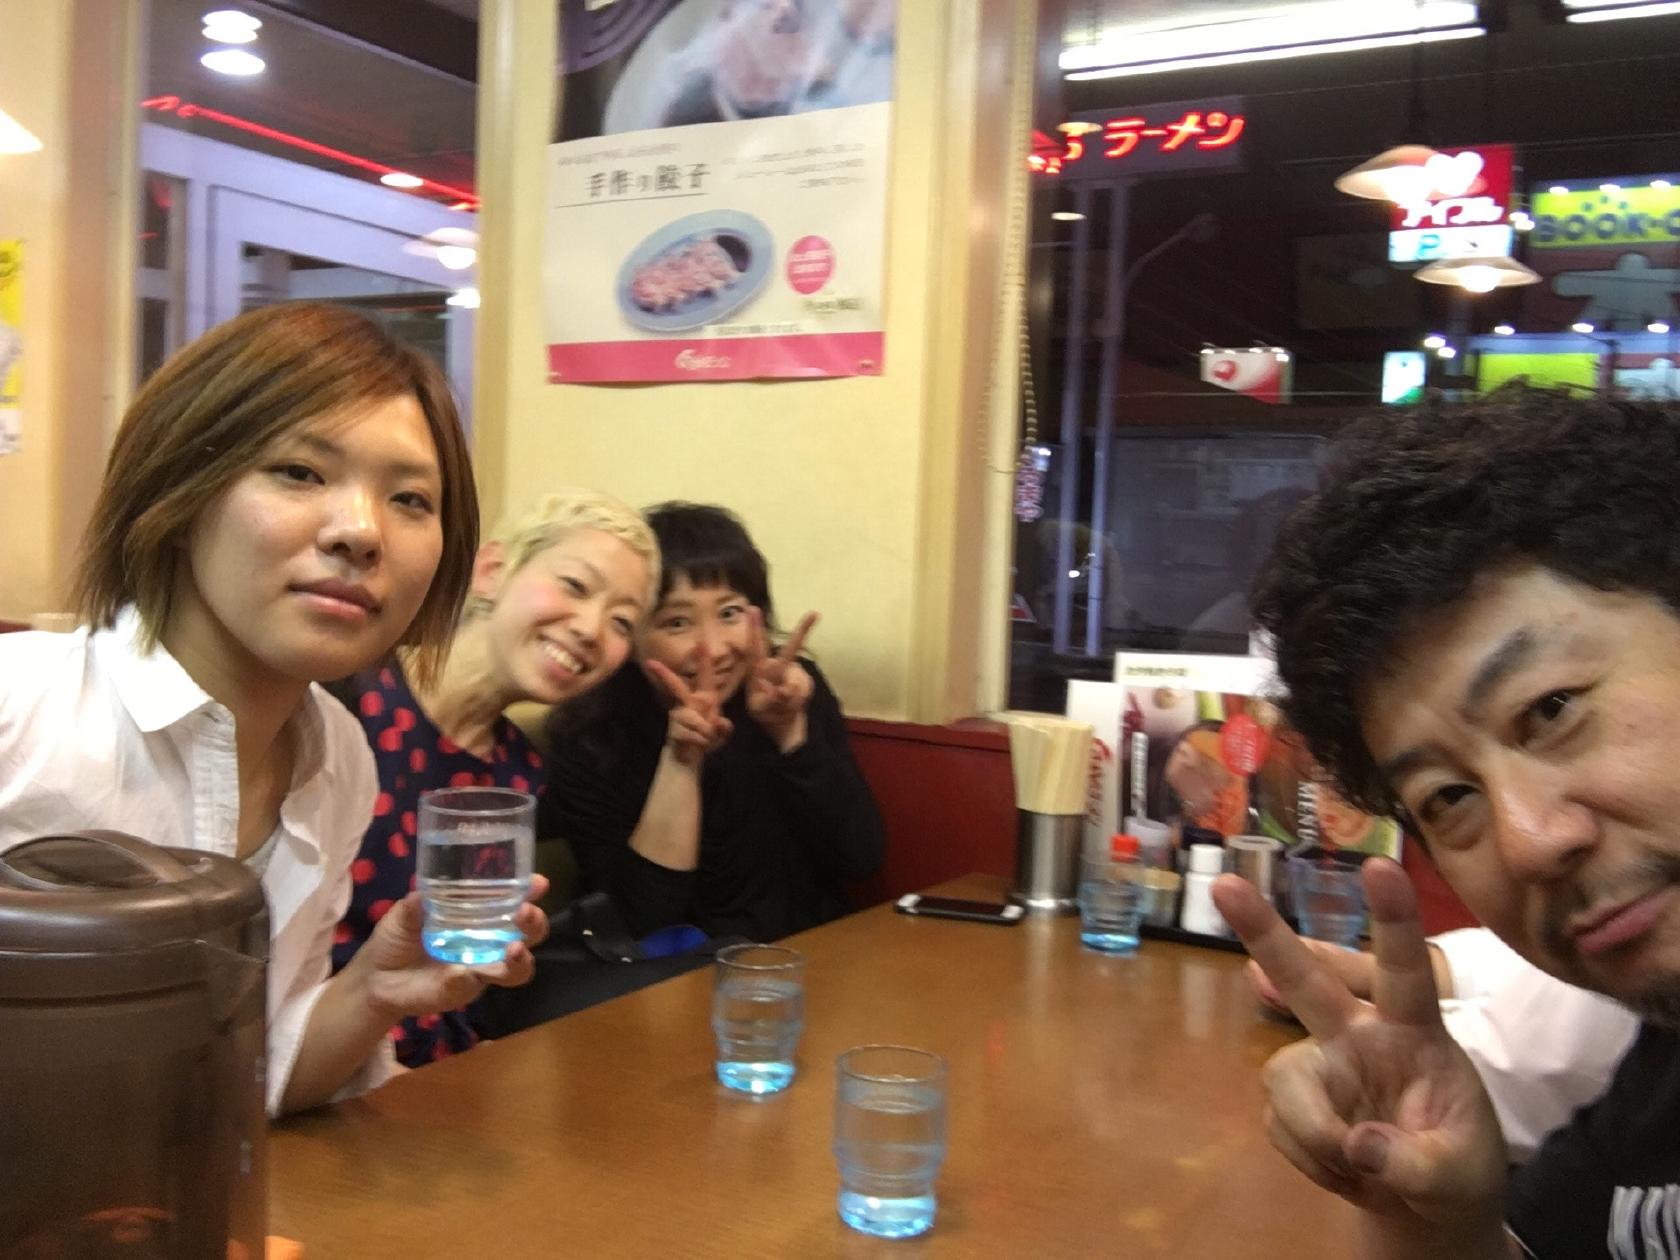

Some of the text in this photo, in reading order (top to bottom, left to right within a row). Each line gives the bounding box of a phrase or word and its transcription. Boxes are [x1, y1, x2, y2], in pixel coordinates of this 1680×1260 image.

[1104, 112, 1245, 158] ラーメン
[1297, 780, 1319, 841] MENU
